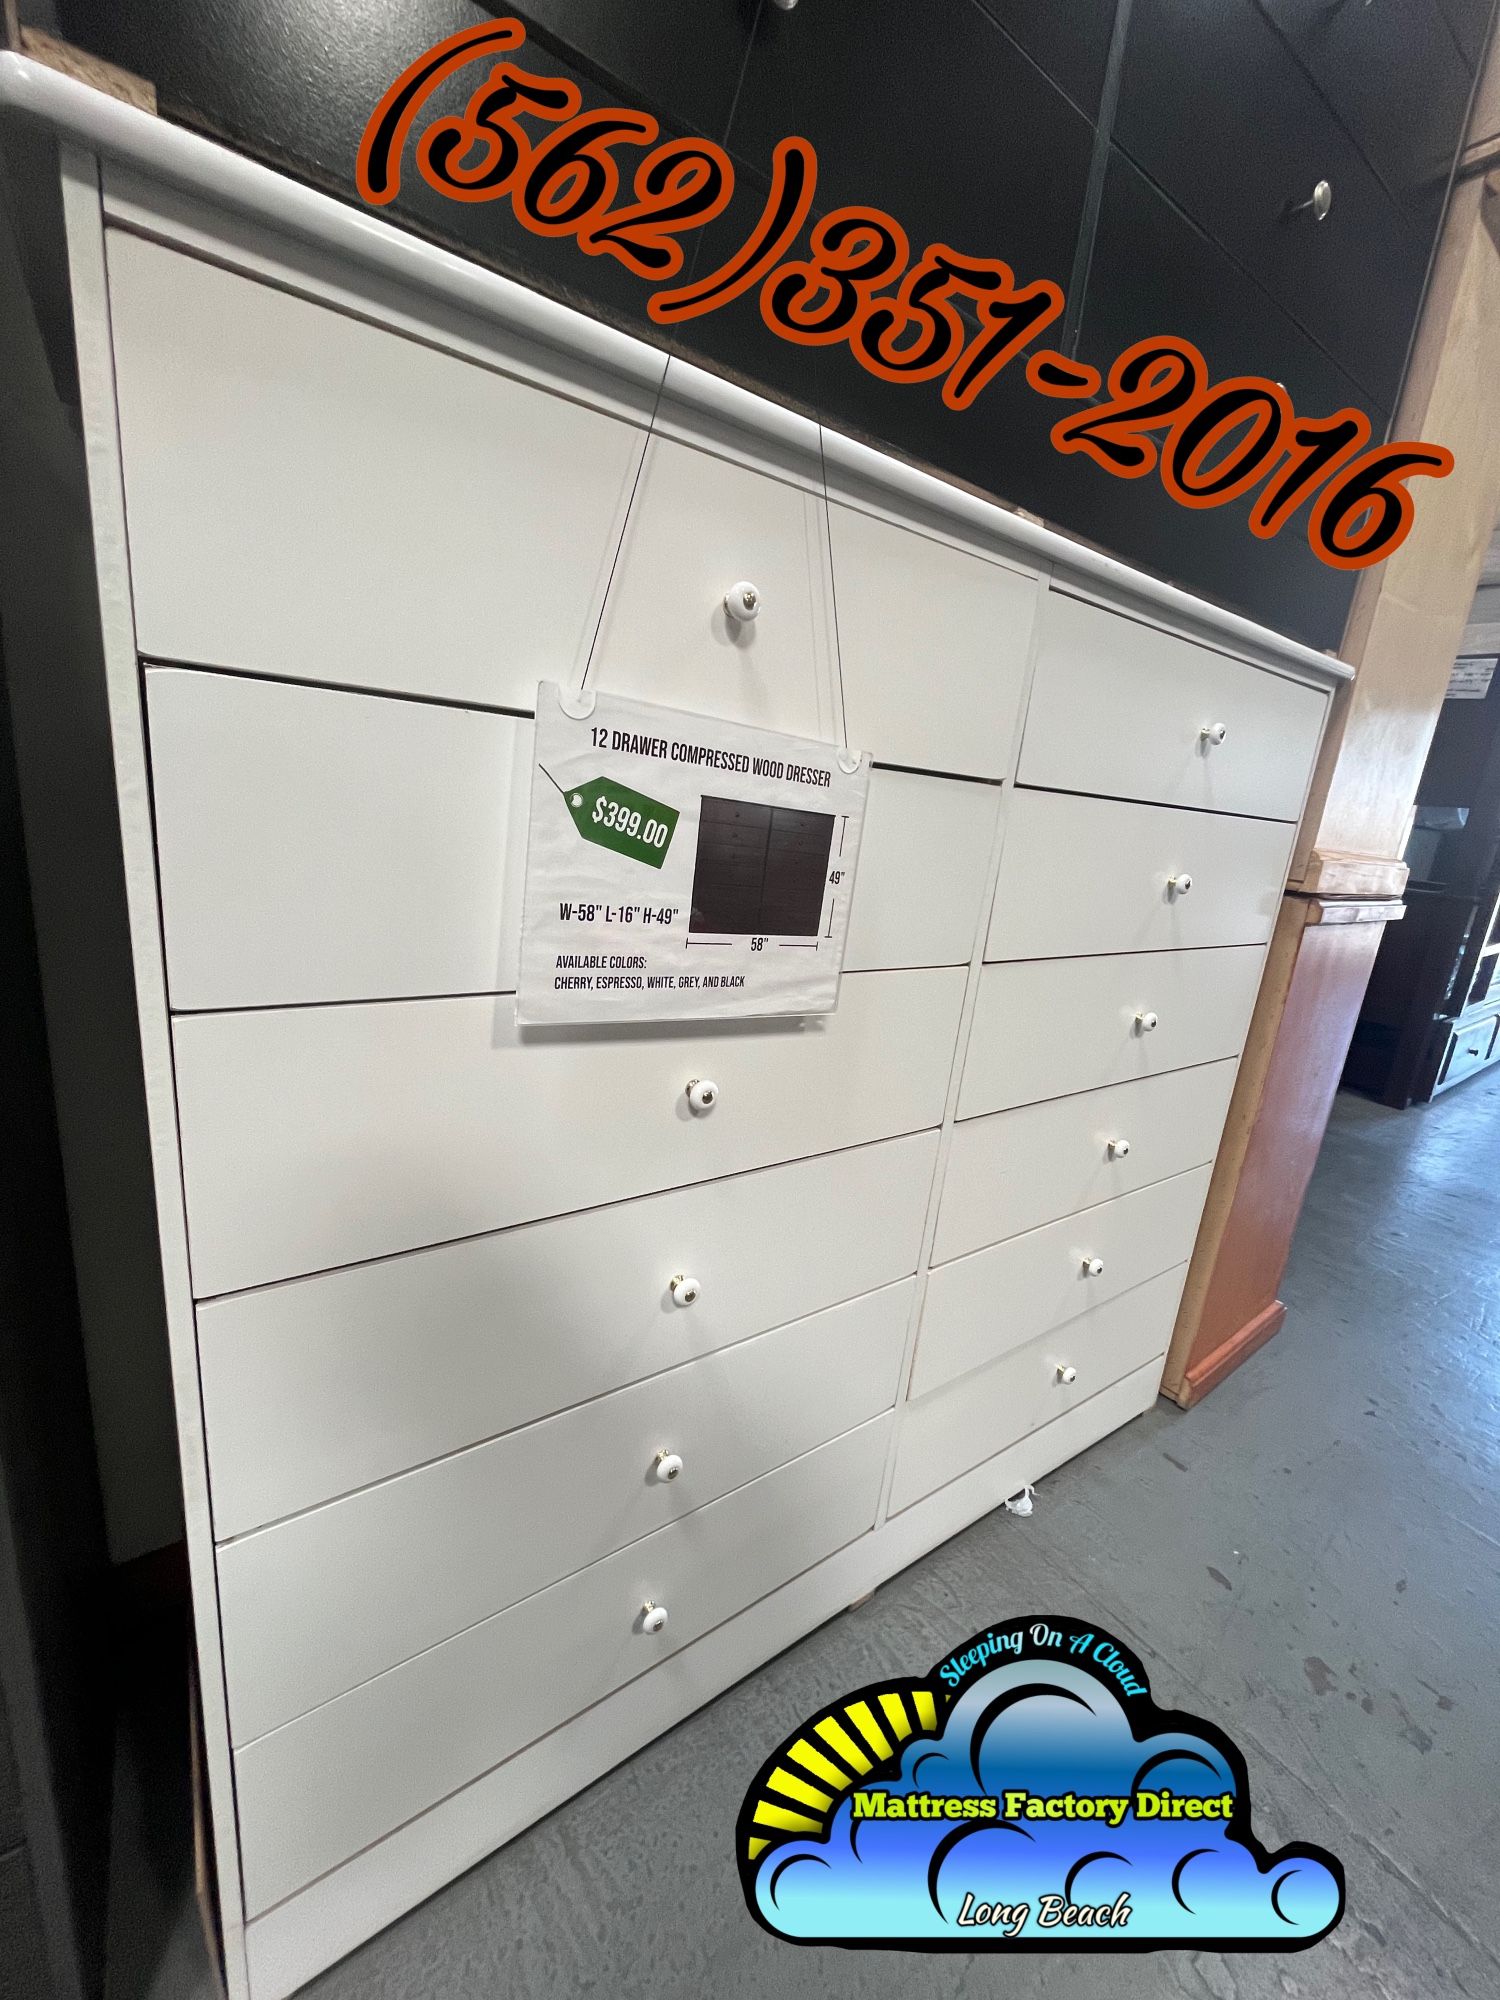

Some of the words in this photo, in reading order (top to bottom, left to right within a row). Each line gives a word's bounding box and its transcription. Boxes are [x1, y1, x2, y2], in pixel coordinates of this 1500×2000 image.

[591, 727, 607, 748] 12
[612, 730, 667, 759] DRAWER
[671, 742, 749, 773] COMPRESSED
[752, 757, 784, 779] WOOD
[786, 765, 831, 788] DRESSER
[592, 796, 668, 849] $399.00
[829, 870, 845, 885] 49"
[560, 903, 602, 921] W-58"
[605, 906, 640, 923] L-16"
[643, 907, 679, 925] H-49"
[751, 937, 769, 951] 58"
[556, 956, 607, 969] AVAILABLE
[609, 956, 647, 969] COLORS:
[554, 976, 594, 990] CHERRY,
[596, 976, 645, 990] ESPRESSO,
[647, 976, 676, 989] WHITE,
[678, 976, 700, 989] GREY,
[702, 976, 719, 988] AND
[720, 976, 745, 988] BLACK
